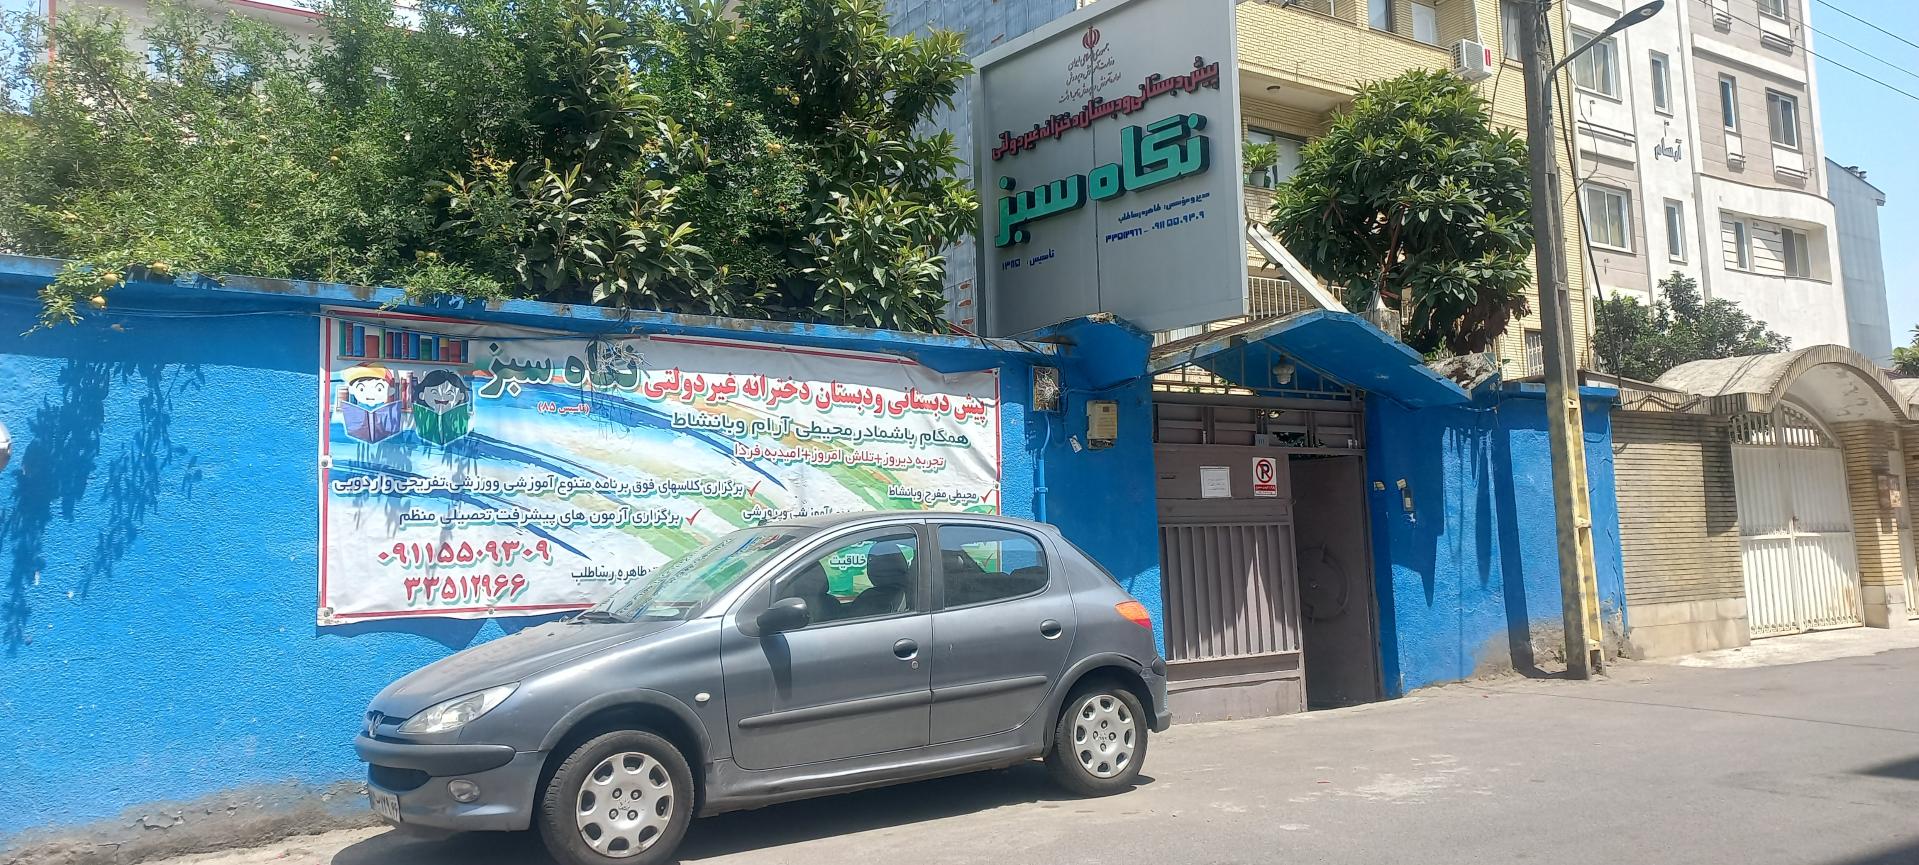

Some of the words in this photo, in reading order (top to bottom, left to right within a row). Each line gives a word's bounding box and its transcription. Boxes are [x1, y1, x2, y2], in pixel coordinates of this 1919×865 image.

[1184, 56, 1220, 94] پیش
[1131, 73, 1184, 110] دبستانی
[1040, 112, 1080, 140] دخترانه
[1088, 113, 1209, 201] نگاه
[995, 175, 1087, 248] سبز
[480, 342, 552, 396] سبز
[743, 373, 810, 406] دخترانه
[888, 386, 950, 416] دبستانی
[954, 393, 985, 422] پیش
[752, 415, 790, 435] آرام
[920, 428, 968, 445] همگام
[735, 444, 761, 458] فردا
[915, 455, 944, 469] تجربه
[504, 474, 554, 492] آموزشی
[557, 478, 592, 495] متنوع
[595, 477, 629, 494] برنامه
[632, 478, 655, 494] فوق
[659, 479, 700, 495] کلاسهای
[703, 479, 743, 496] برگزاری
[925, 490, 947, 504] مفرح
[949, 488, 977, 502] محیطی
[400, 507, 435, 525] منظم
[440, 508, 491, 525] تحصیلی
[496, 508, 556, 526] پیشرفت
[560, 508, 585, 523] های
[589, 506, 629, 523] آزمون
[632, 508, 680, 524] برگزاری
[378, 539, 550, 564] ۰۹۱۱۵۵۰۹۳۰۹
[830, 554, 866, 569] خلاقیت
[618, 564, 647, 580] طاهره
[404, 573, 526, 601] ۳۳۵۱۲۹۶۶
